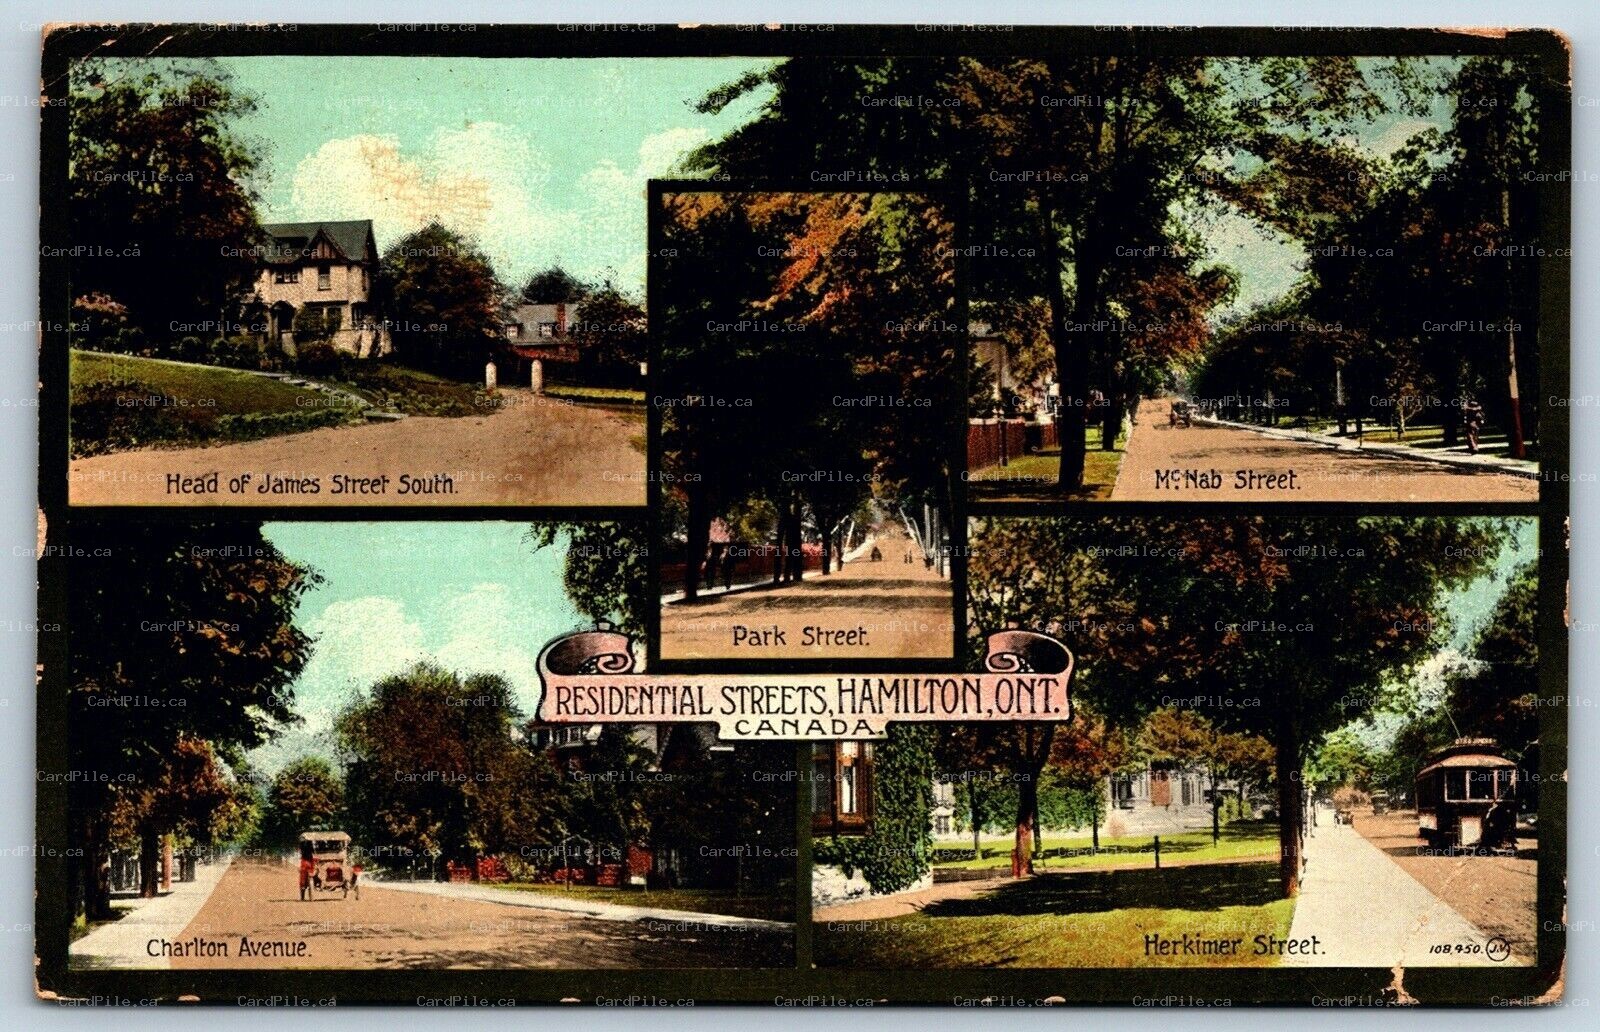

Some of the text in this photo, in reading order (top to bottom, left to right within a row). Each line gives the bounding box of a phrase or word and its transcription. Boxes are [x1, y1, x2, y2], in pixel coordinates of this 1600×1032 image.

[166, 473, 459, 494] Head of James Street South.
[1234, 469, 1301, 490] Street.
[733, 625, 870, 646] Park Street.
[555, 678, 1060, 717] RESIDENTIAL STREETS, HAMILTON, ONT.
[735, 719, 884, 736] CANADA.
[146, 937, 313, 957] Charlton Avenue.
[1144, 933, 1326, 956] Herkimer Street.
